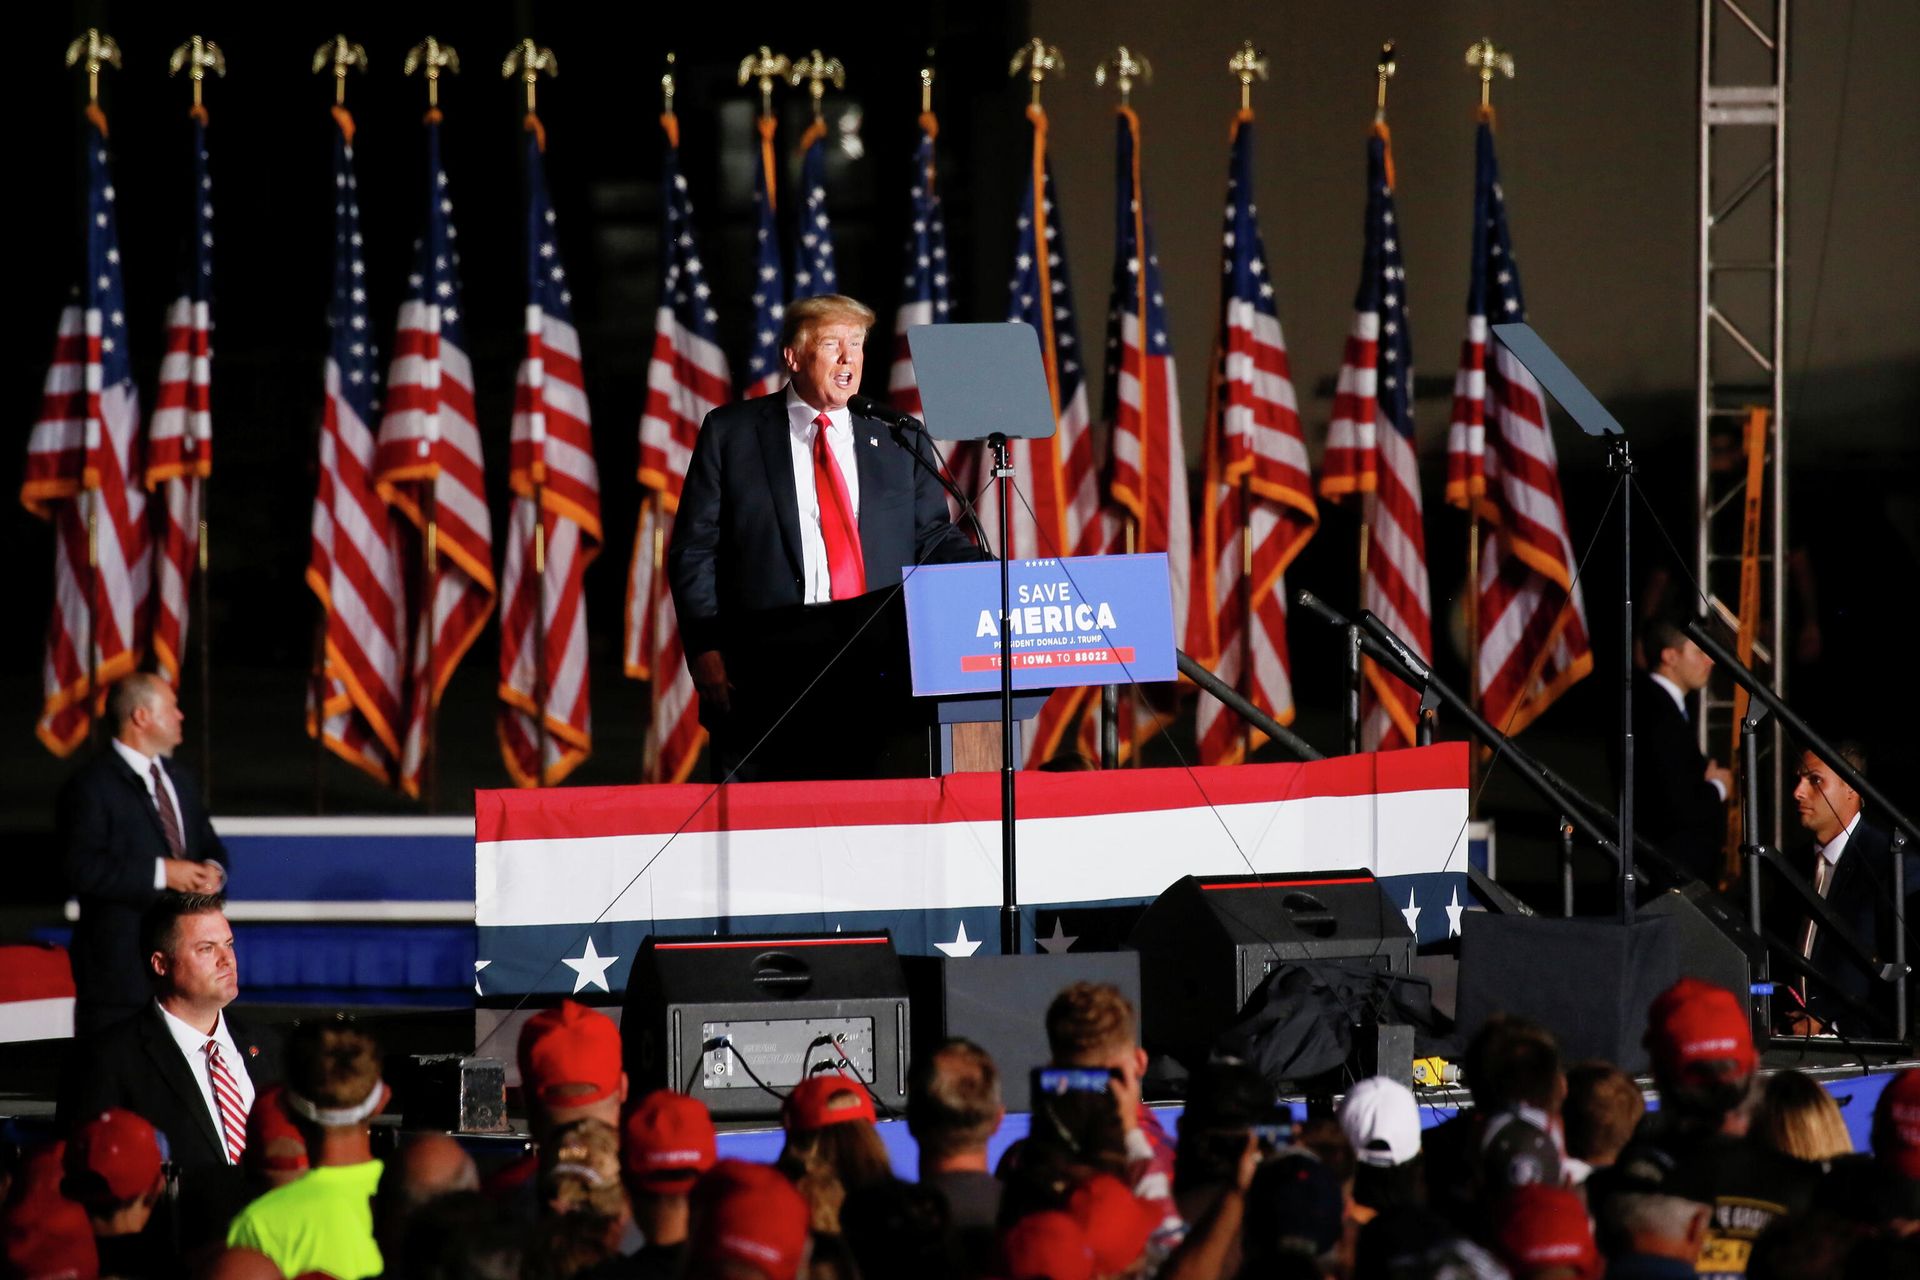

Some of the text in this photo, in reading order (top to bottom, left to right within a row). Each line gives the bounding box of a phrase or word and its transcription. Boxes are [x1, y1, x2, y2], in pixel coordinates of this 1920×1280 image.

[1018, 582, 1070, 603] SAVE
[976, 602, 1117, 638] AMERICA
[1036, 636, 1068, 646] DONALD
[1069, 635, 1076, 645] J.
[1077, 635, 1102, 643] TRUMP
[990, 651, 1108, 667] TET IOWA TO 88022
